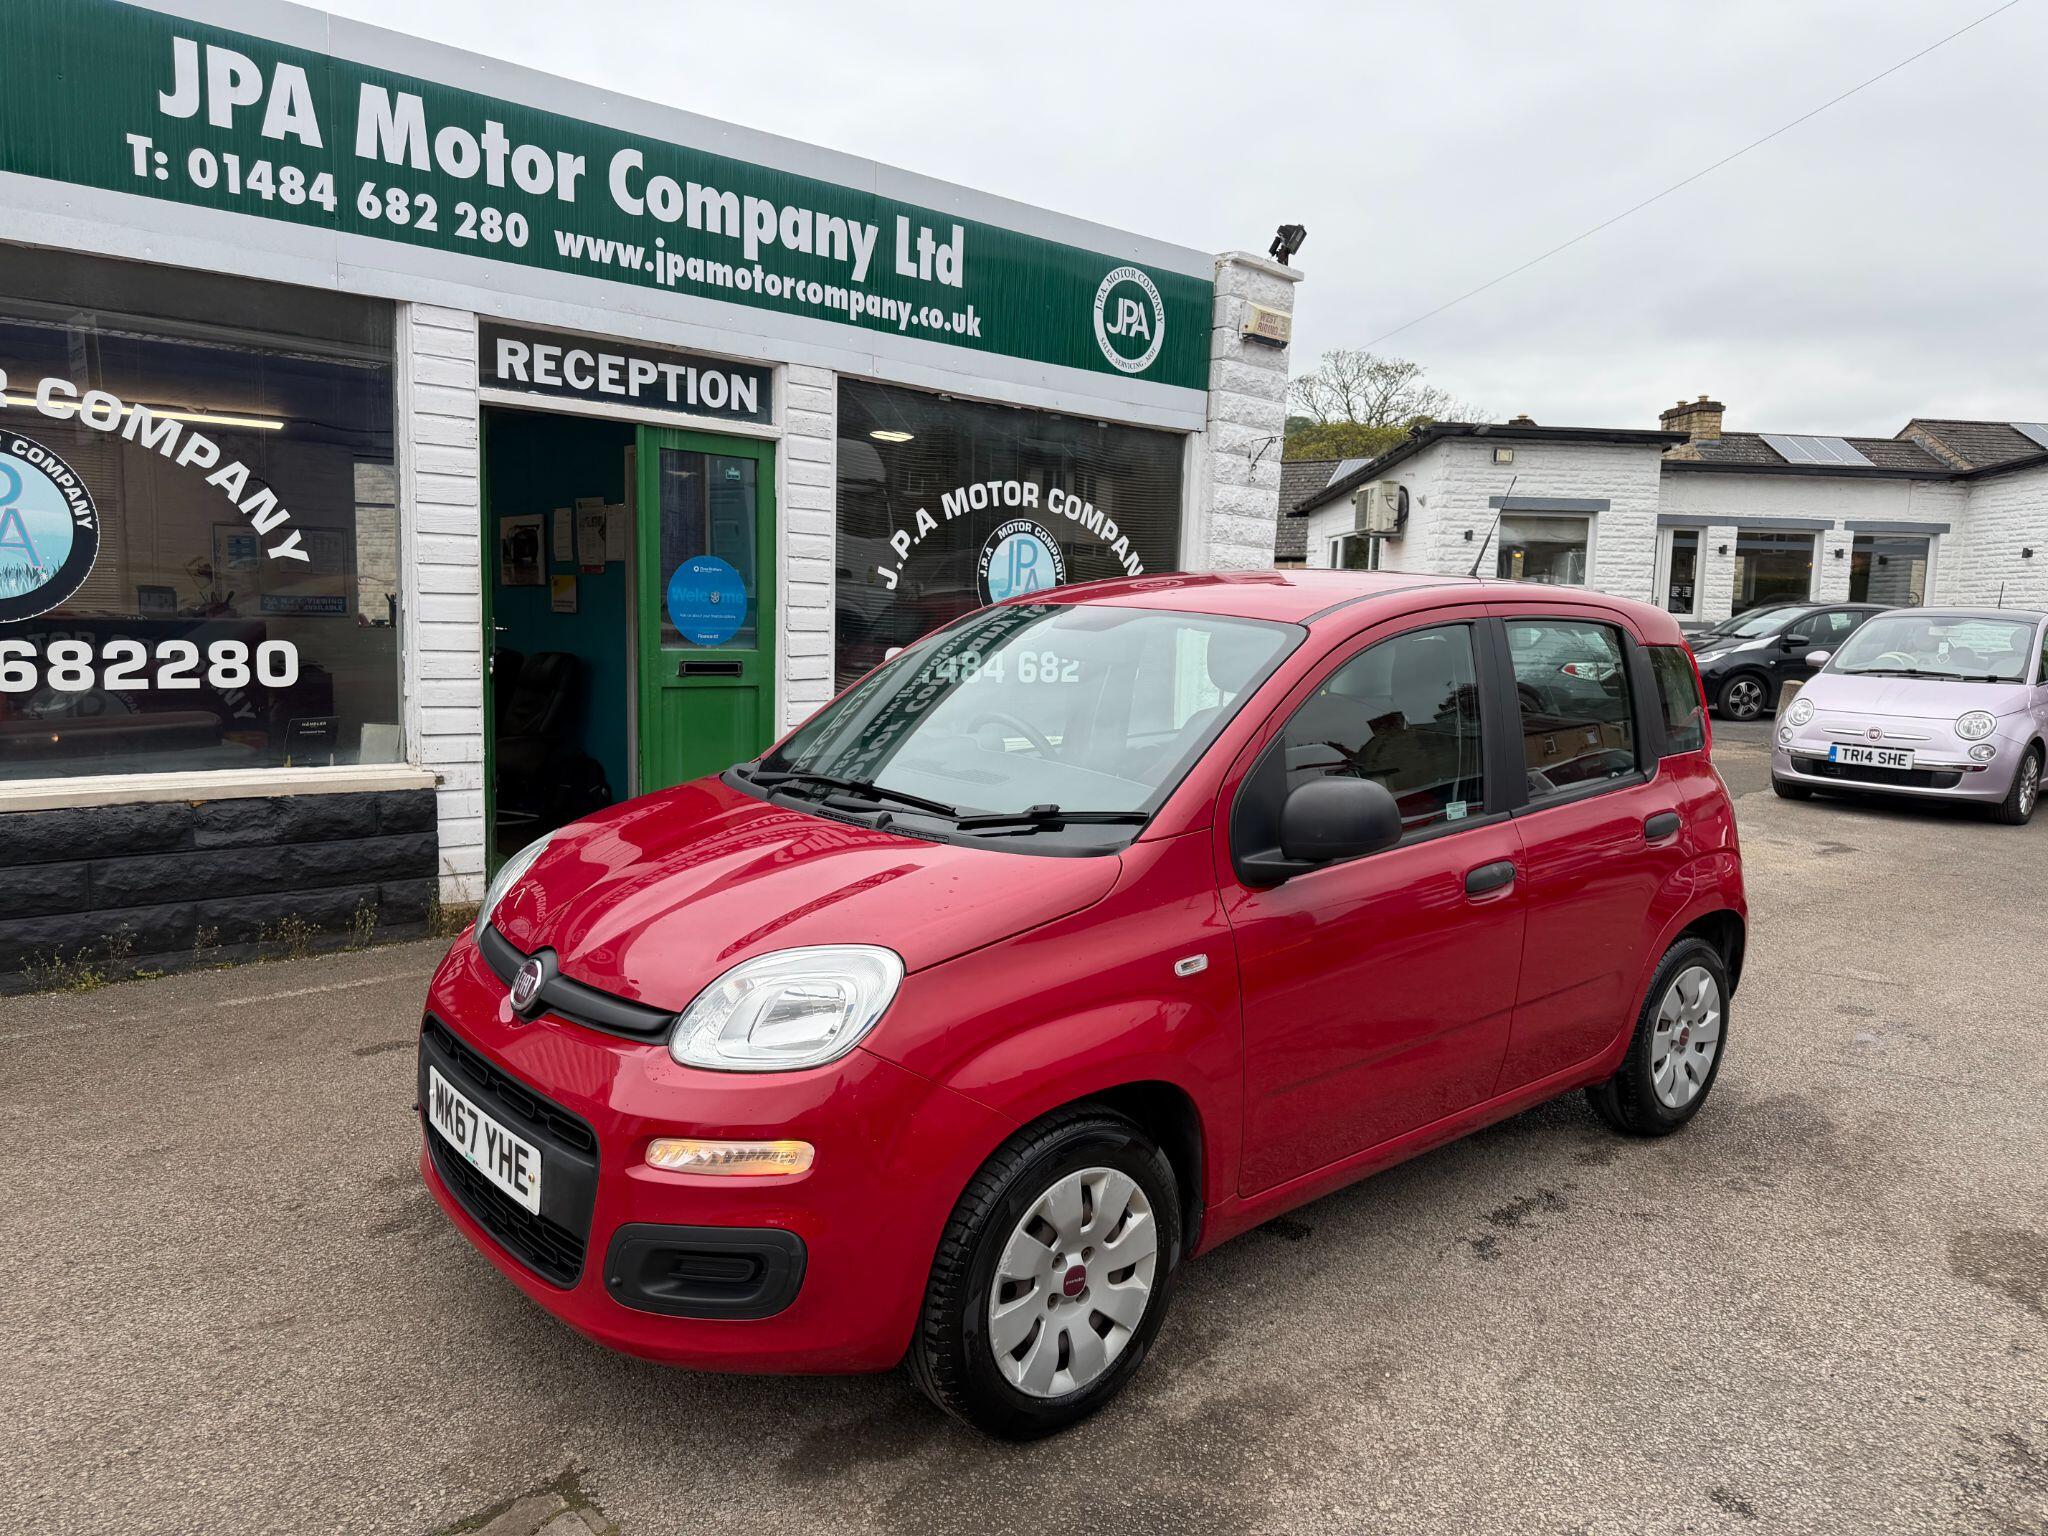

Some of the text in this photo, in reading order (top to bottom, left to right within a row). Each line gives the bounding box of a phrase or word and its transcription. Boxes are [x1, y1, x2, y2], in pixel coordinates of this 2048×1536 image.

[159, 37, 965, 288] JPA Motor Company Ltd
[126, 133, 982, 338] T: 01484 682 280 www.jpamotorcompany.co.uk
[1106, 268, 1136, 287] MOTOR
[1138, 273, 1164, 325] COMPANY
[1106, 297, 1151, 341] JPA
[496, 338, 758, 414] RECEPTION
[11, 439, 93, 530] COMPANY
[36, 377, 310, 564] COMPANY
[877, 480, 1145, 591] J.P.A MOTOR COMPAN
[997, 522, 1032, 540] MOTOR
[1034, 527, 1064, 581] COMPANY
[671, 586, 745, 604] Welcme
[0, 640, 299, 693] 682280
[1842, 748, 1908, 767] TR14 SHE
[435, 1077, 529, 1197] MK67 YHE
